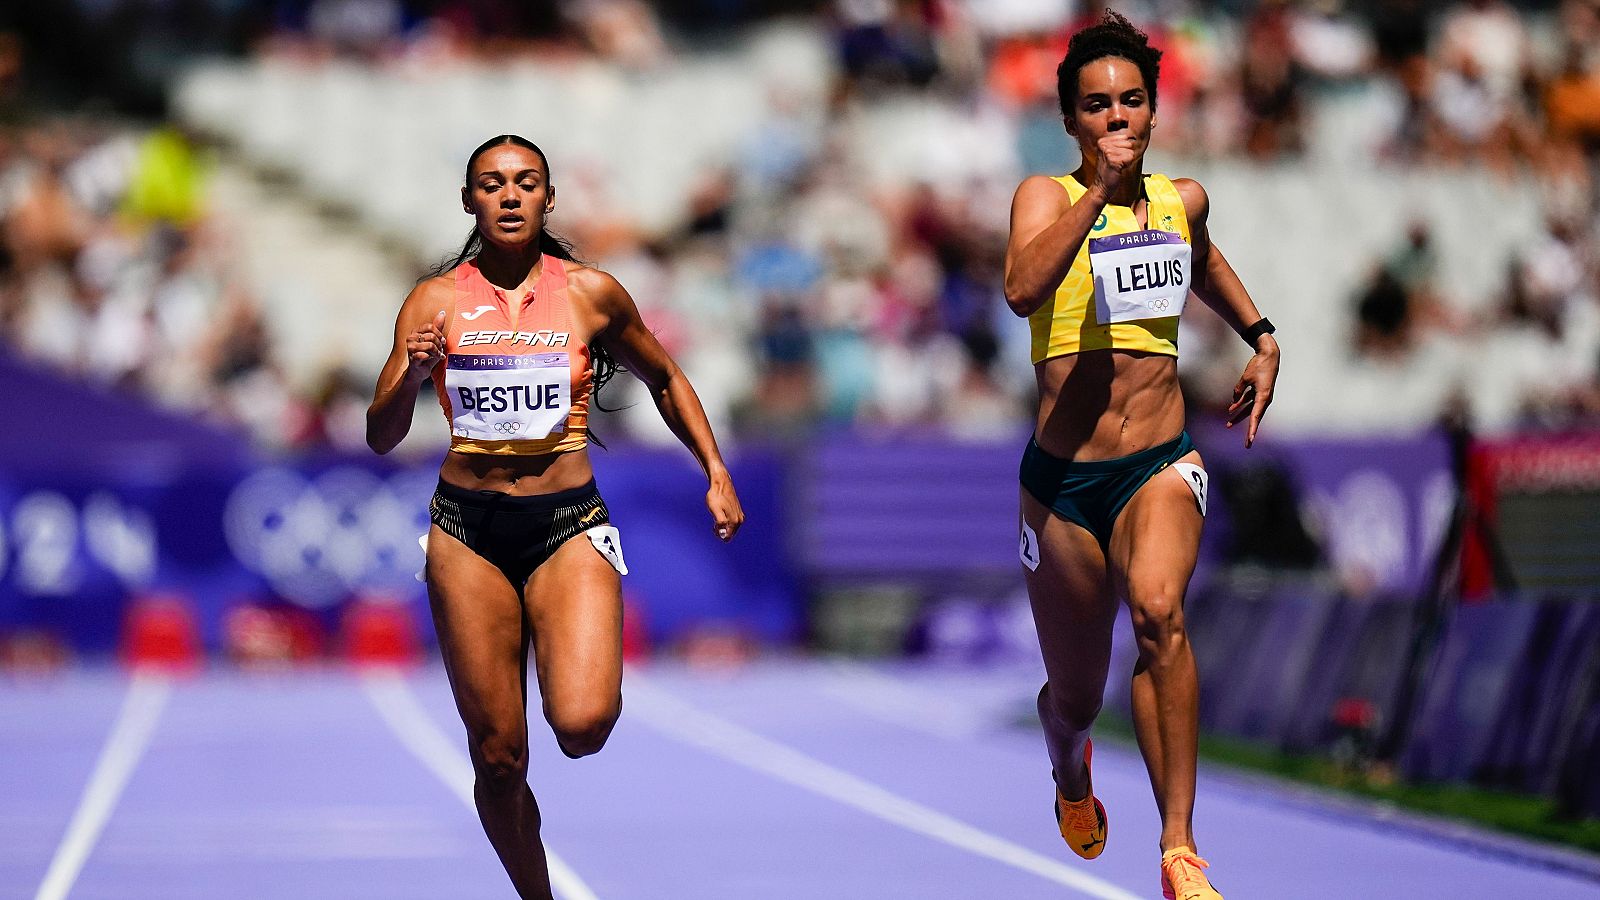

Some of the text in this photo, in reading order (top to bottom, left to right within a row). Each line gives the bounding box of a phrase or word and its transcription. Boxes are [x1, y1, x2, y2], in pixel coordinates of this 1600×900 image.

[1119, 233, 1149, 246] PARIS
[1115, 259, 1184, 294] LEWIS
[458, 329, 570, 348] ESPAÑA
[473, 357, 536, 366] PARIS 2024
[458, 384, 560, 413] BESTUE
[1191, 470, 1204, 501] 2
[1022, 530, 1034, 562] 2
